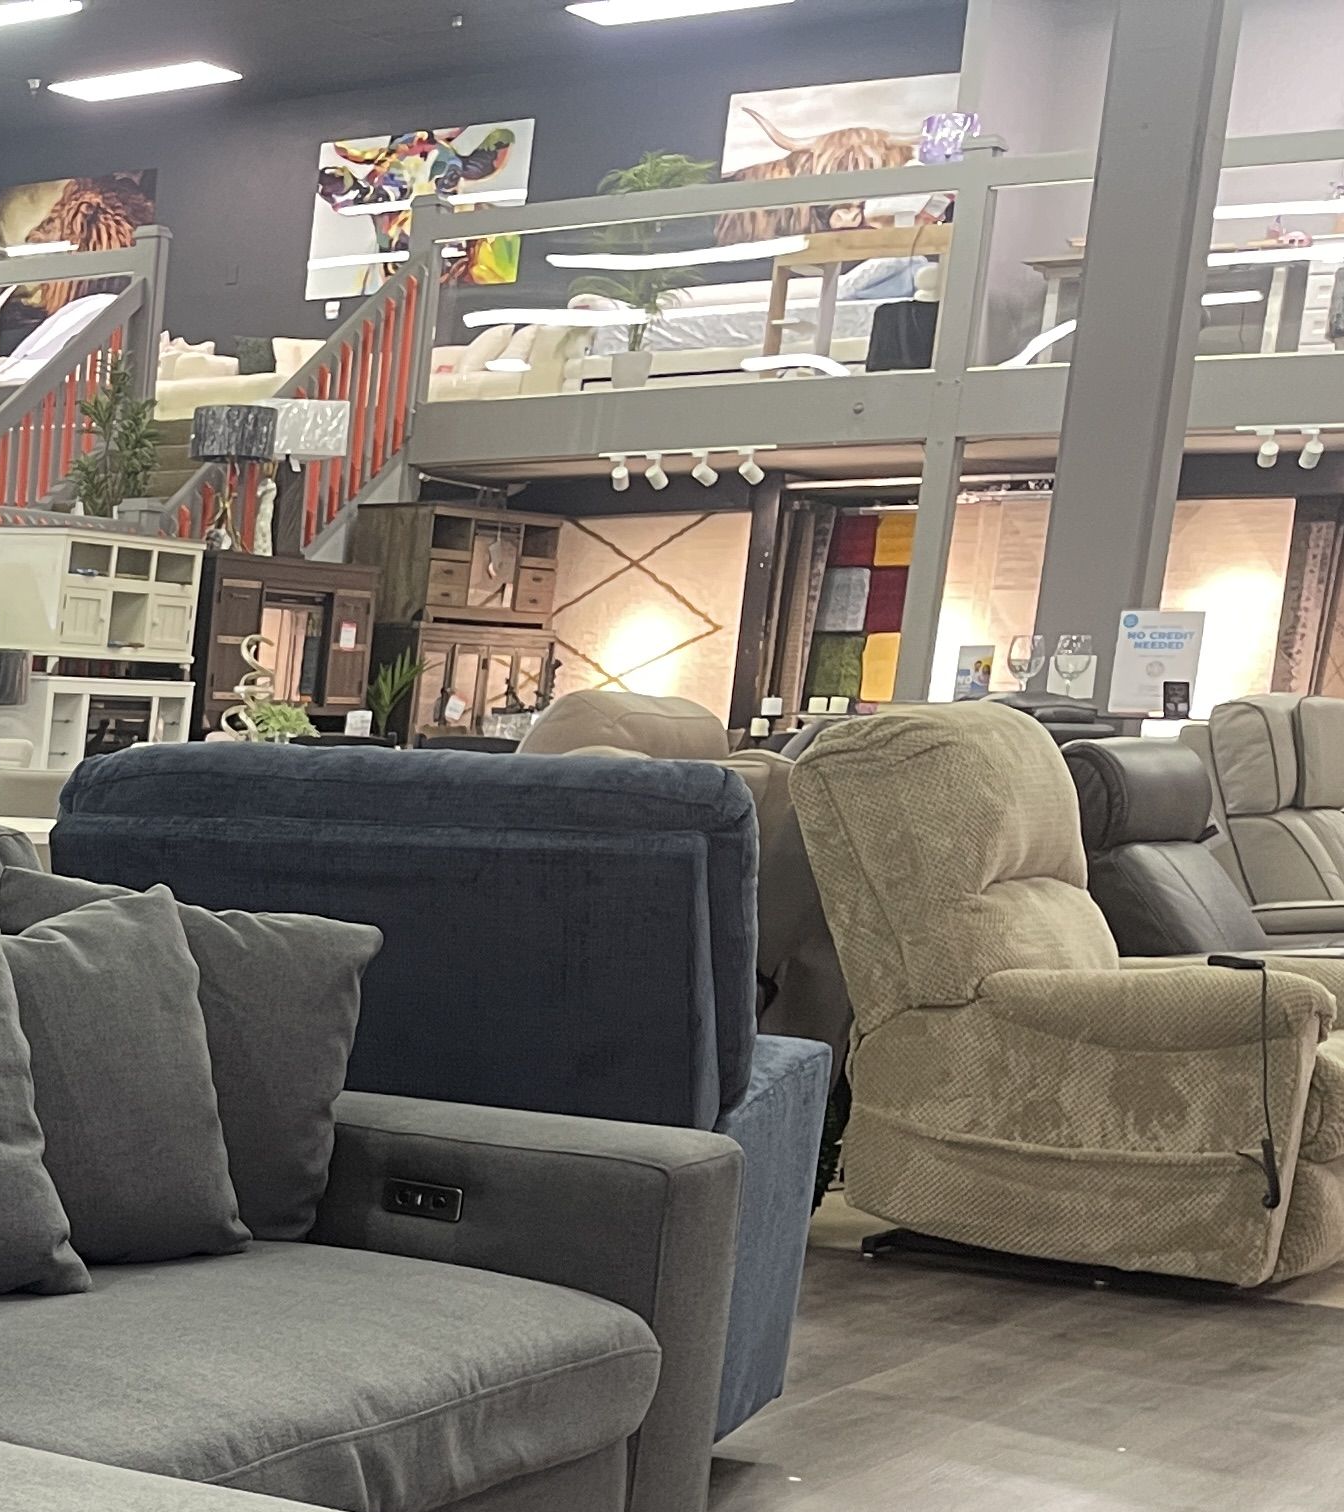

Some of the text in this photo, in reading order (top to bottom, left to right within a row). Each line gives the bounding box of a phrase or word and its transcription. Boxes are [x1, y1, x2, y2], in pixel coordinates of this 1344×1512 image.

[1127, 631, 1195, 640] NO CREDIT
[1134, 641, 1184, 649] NEEDED
